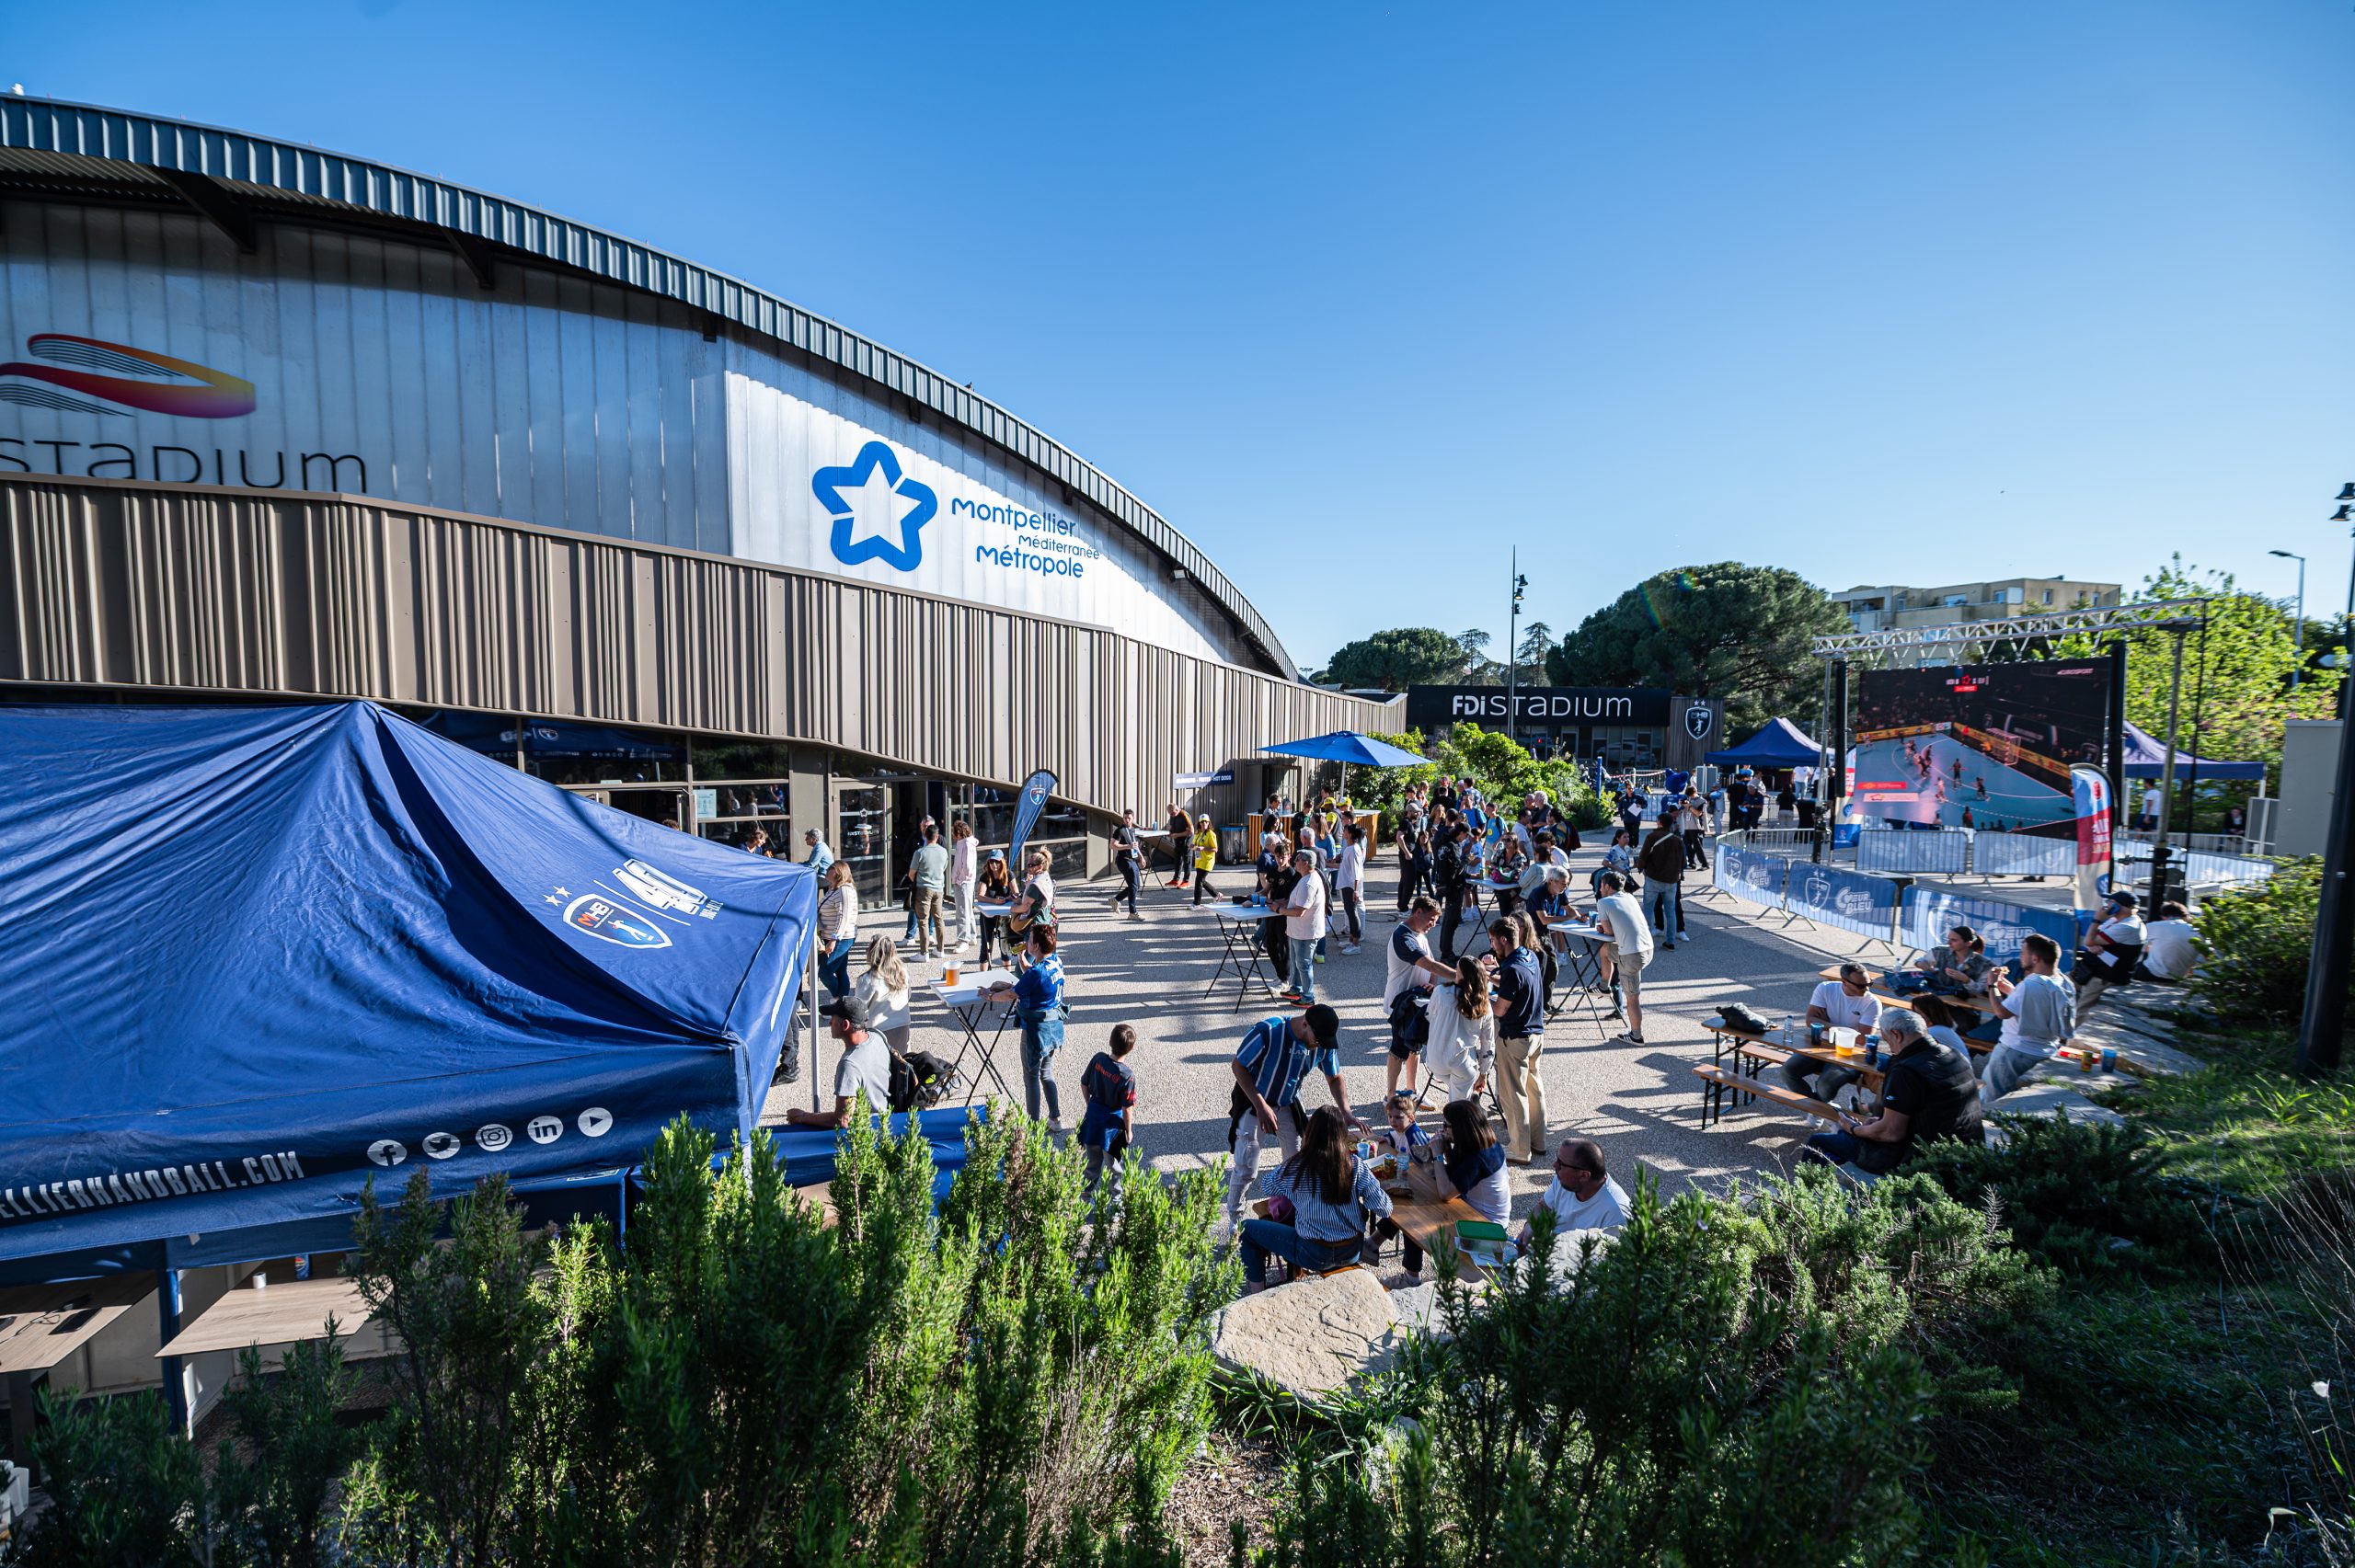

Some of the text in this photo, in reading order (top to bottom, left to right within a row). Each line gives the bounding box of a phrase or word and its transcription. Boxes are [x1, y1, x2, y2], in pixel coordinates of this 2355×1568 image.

[951, 498, 1076, 537] Montpellier
[1018, 534, 1100, 560] Méditerranée
[976, 544, 1084, 578] Métropole
[576, 901, 610, 927] MHB
[1845, 900, 1873, 915] BLEU
[1997, 938, 2023, 954] BLE
